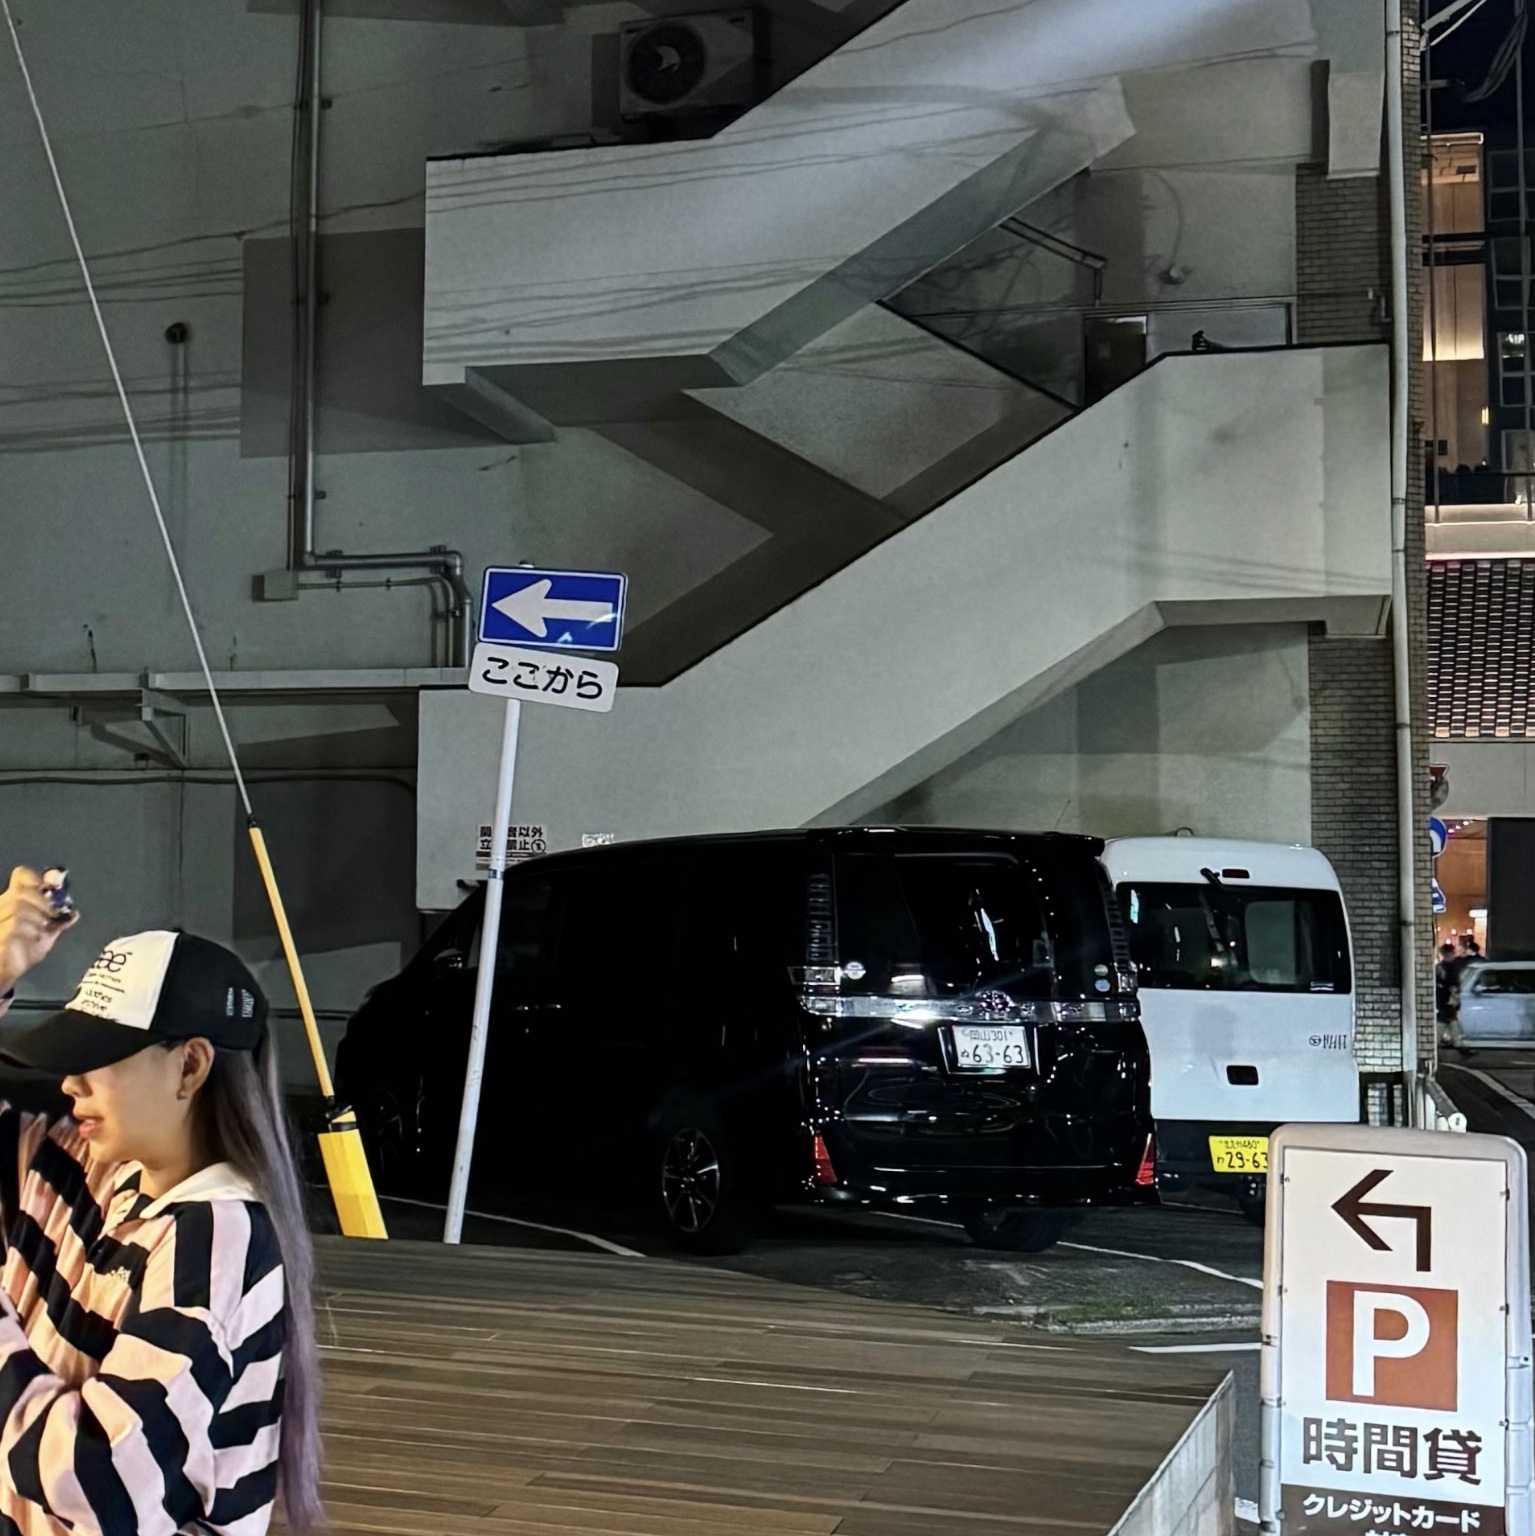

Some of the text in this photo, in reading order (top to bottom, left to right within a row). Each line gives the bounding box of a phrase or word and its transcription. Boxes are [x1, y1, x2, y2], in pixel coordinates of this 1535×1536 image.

[482, 656, 603, 699] ここから
[972, 1043, 1024, 1064] 63-63
[1352, 1289, 1432, 1398] P
[1302, 1416, 1482, 1487] 時間貸
[1302, 1493, 1481, 1534] クレジットカード
